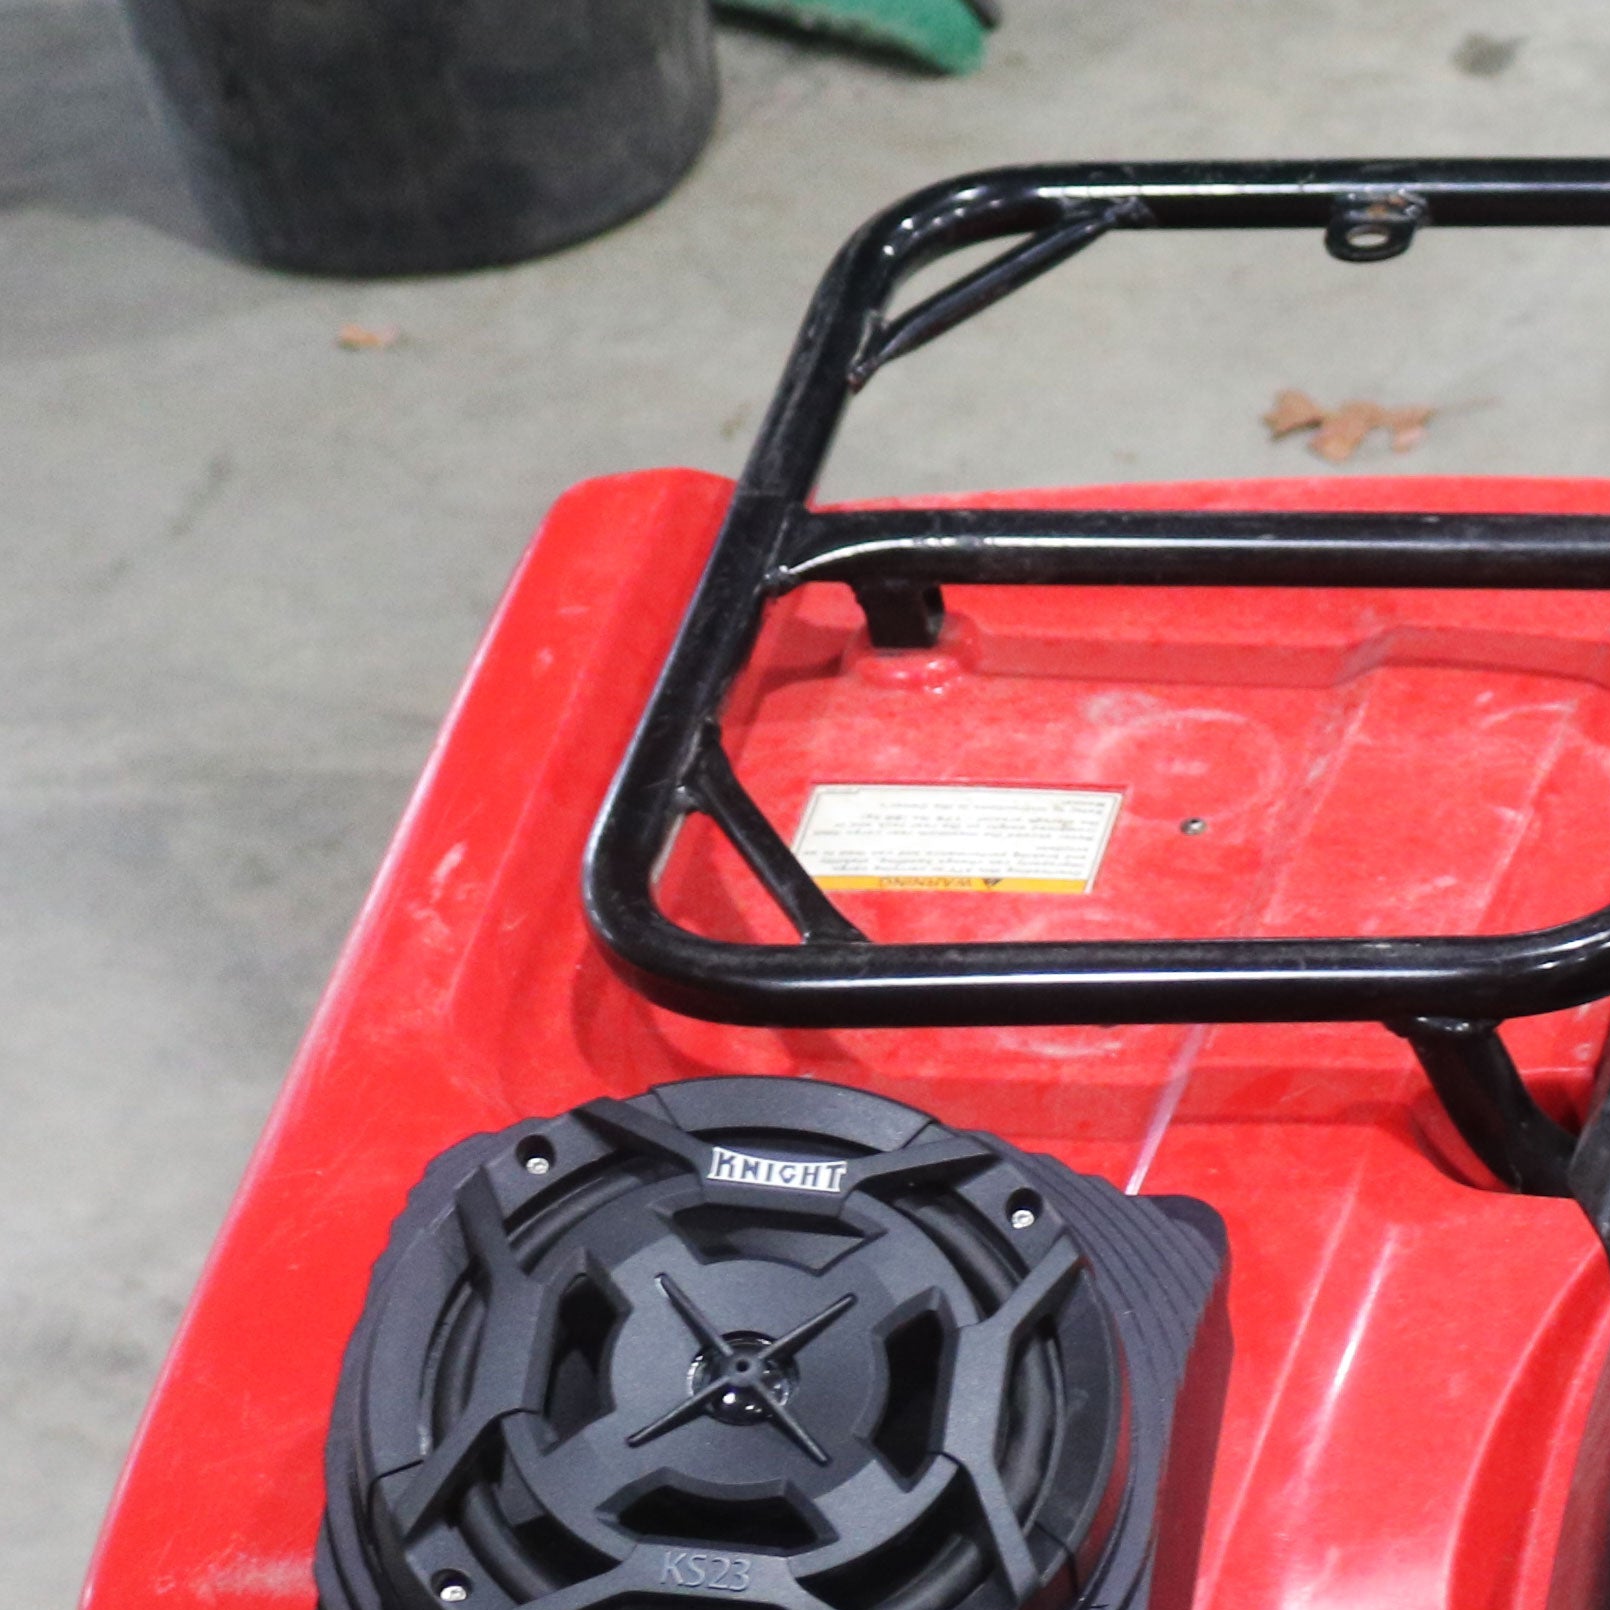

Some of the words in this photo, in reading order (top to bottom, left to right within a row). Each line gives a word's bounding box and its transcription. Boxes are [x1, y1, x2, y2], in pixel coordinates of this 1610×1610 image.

[878, 876, 972, 889] WARNING
[713, 1150, 844, 1190] KNIGHT
[660, 1551, 750, 1593] KS23
